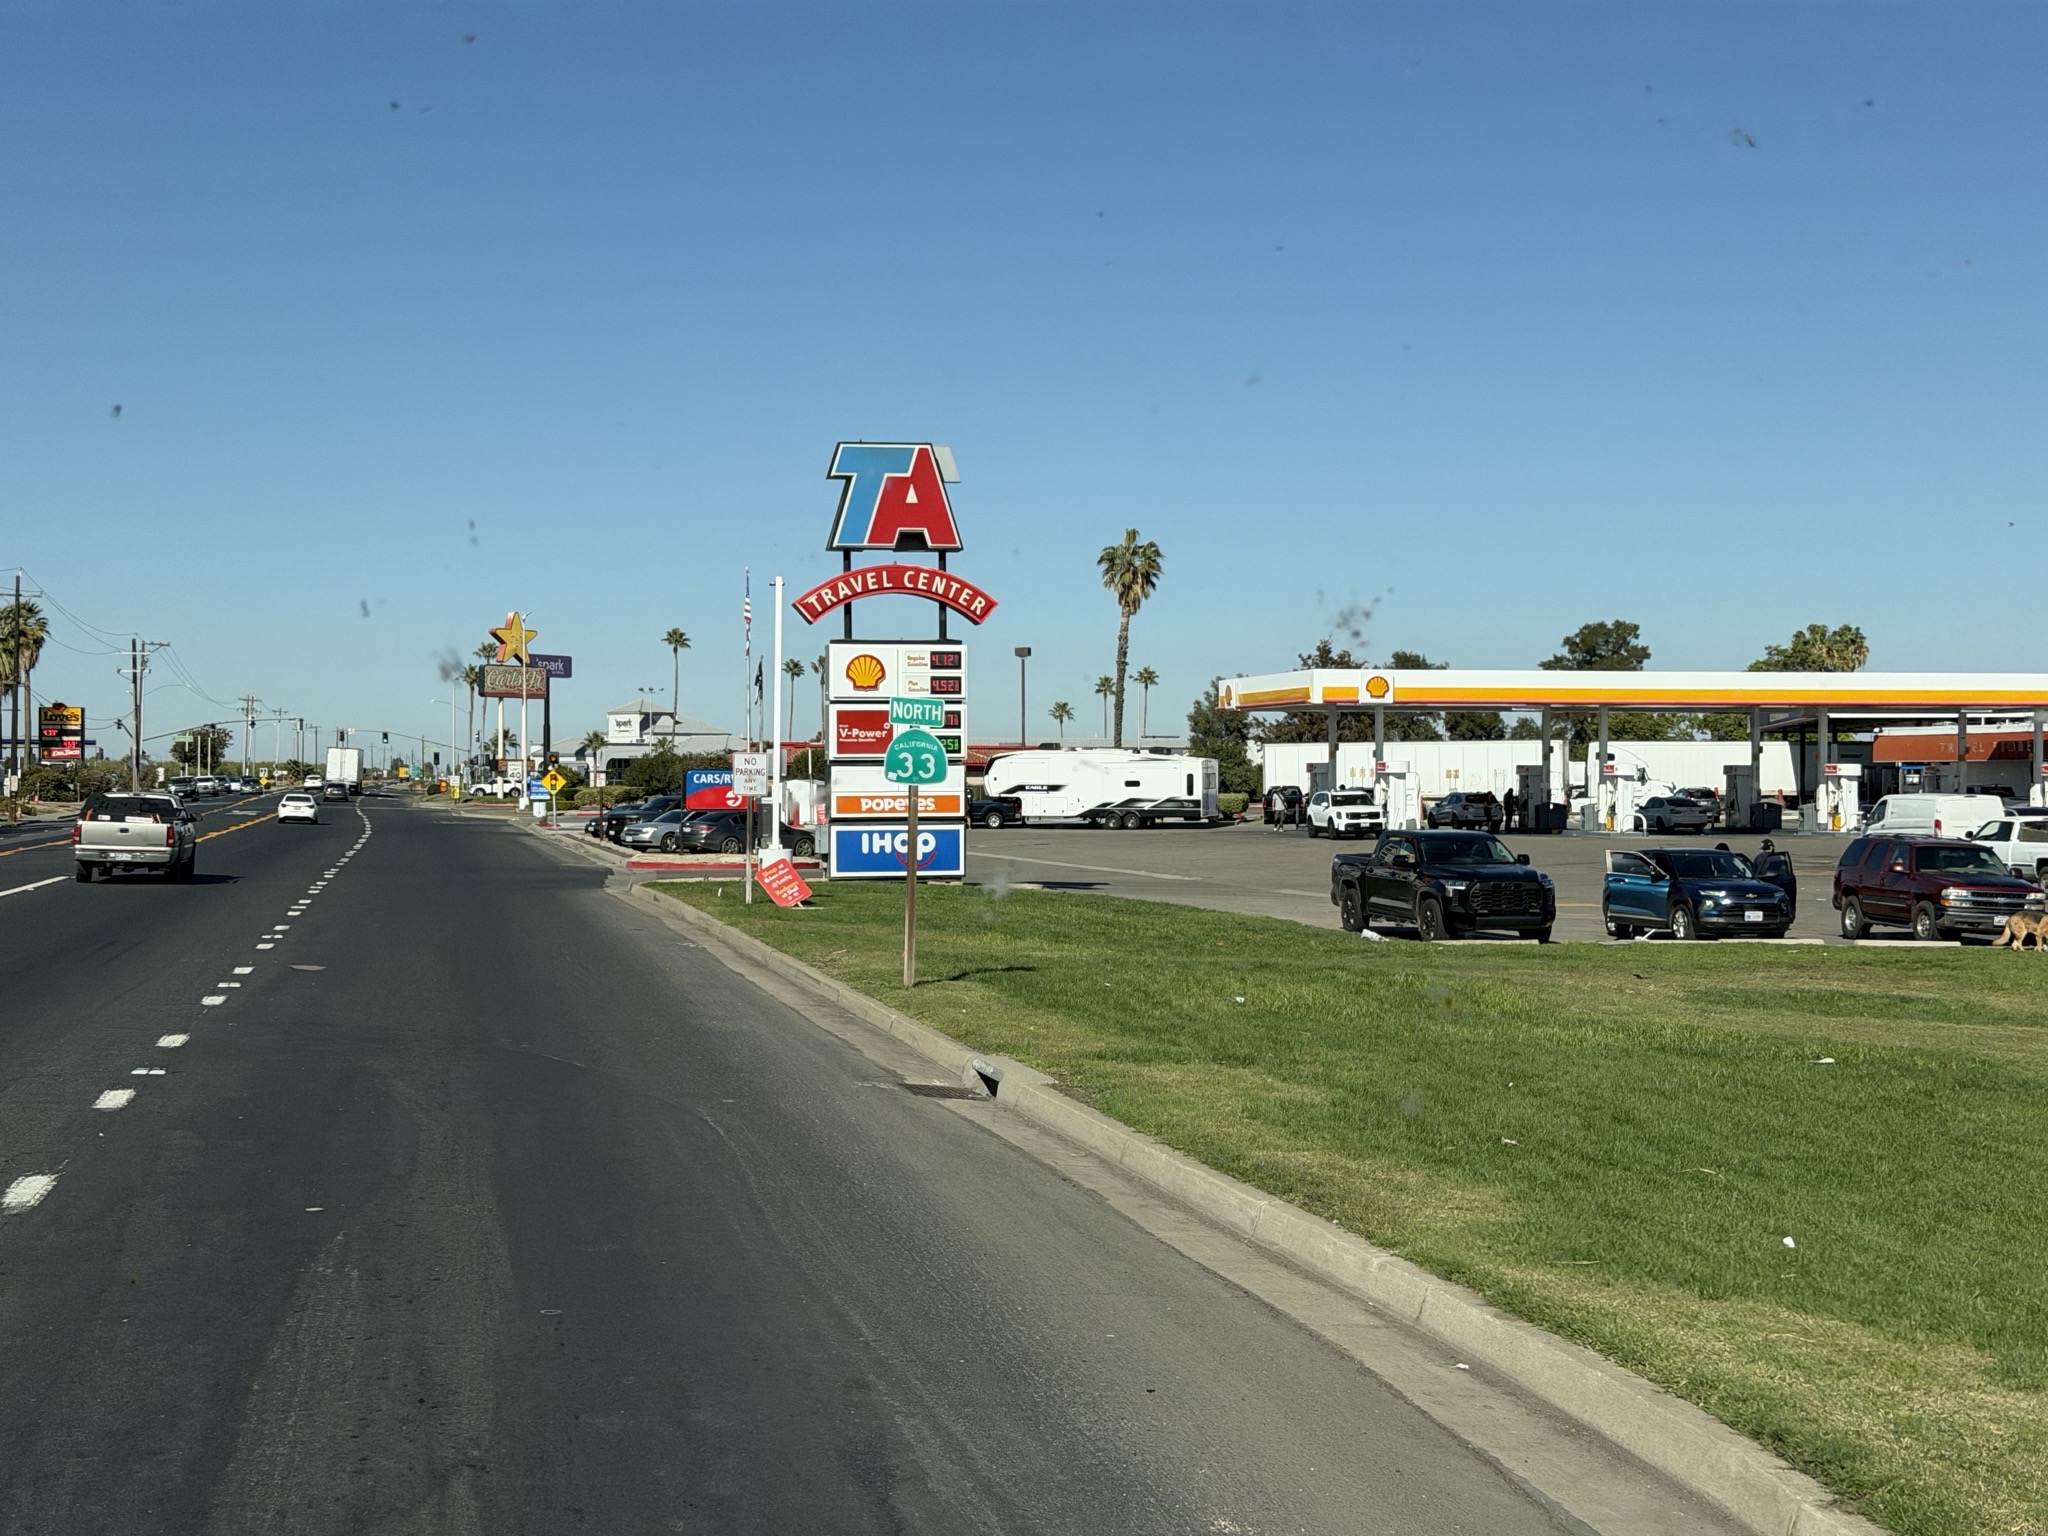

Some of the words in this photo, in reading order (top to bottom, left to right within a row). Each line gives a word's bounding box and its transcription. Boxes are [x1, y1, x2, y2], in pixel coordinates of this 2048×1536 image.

[831, 444, 961, 549] TA
[806, 570, 893, 613] TRAVEL
[903, 570, 986, 616] CENTER
[892, 701, 942, 722] NORTH
[839, 728, 888, 738] V-Power
[894, 741, 938, 750] CALIFORNIA
[744, 757, 757, 766] NO
[896, 752, 936, 779] 33
[509, 771, 522, 779] 40
[735, 767, 766, 776] PARKING
[860, 797, 936, 812] POPEES
